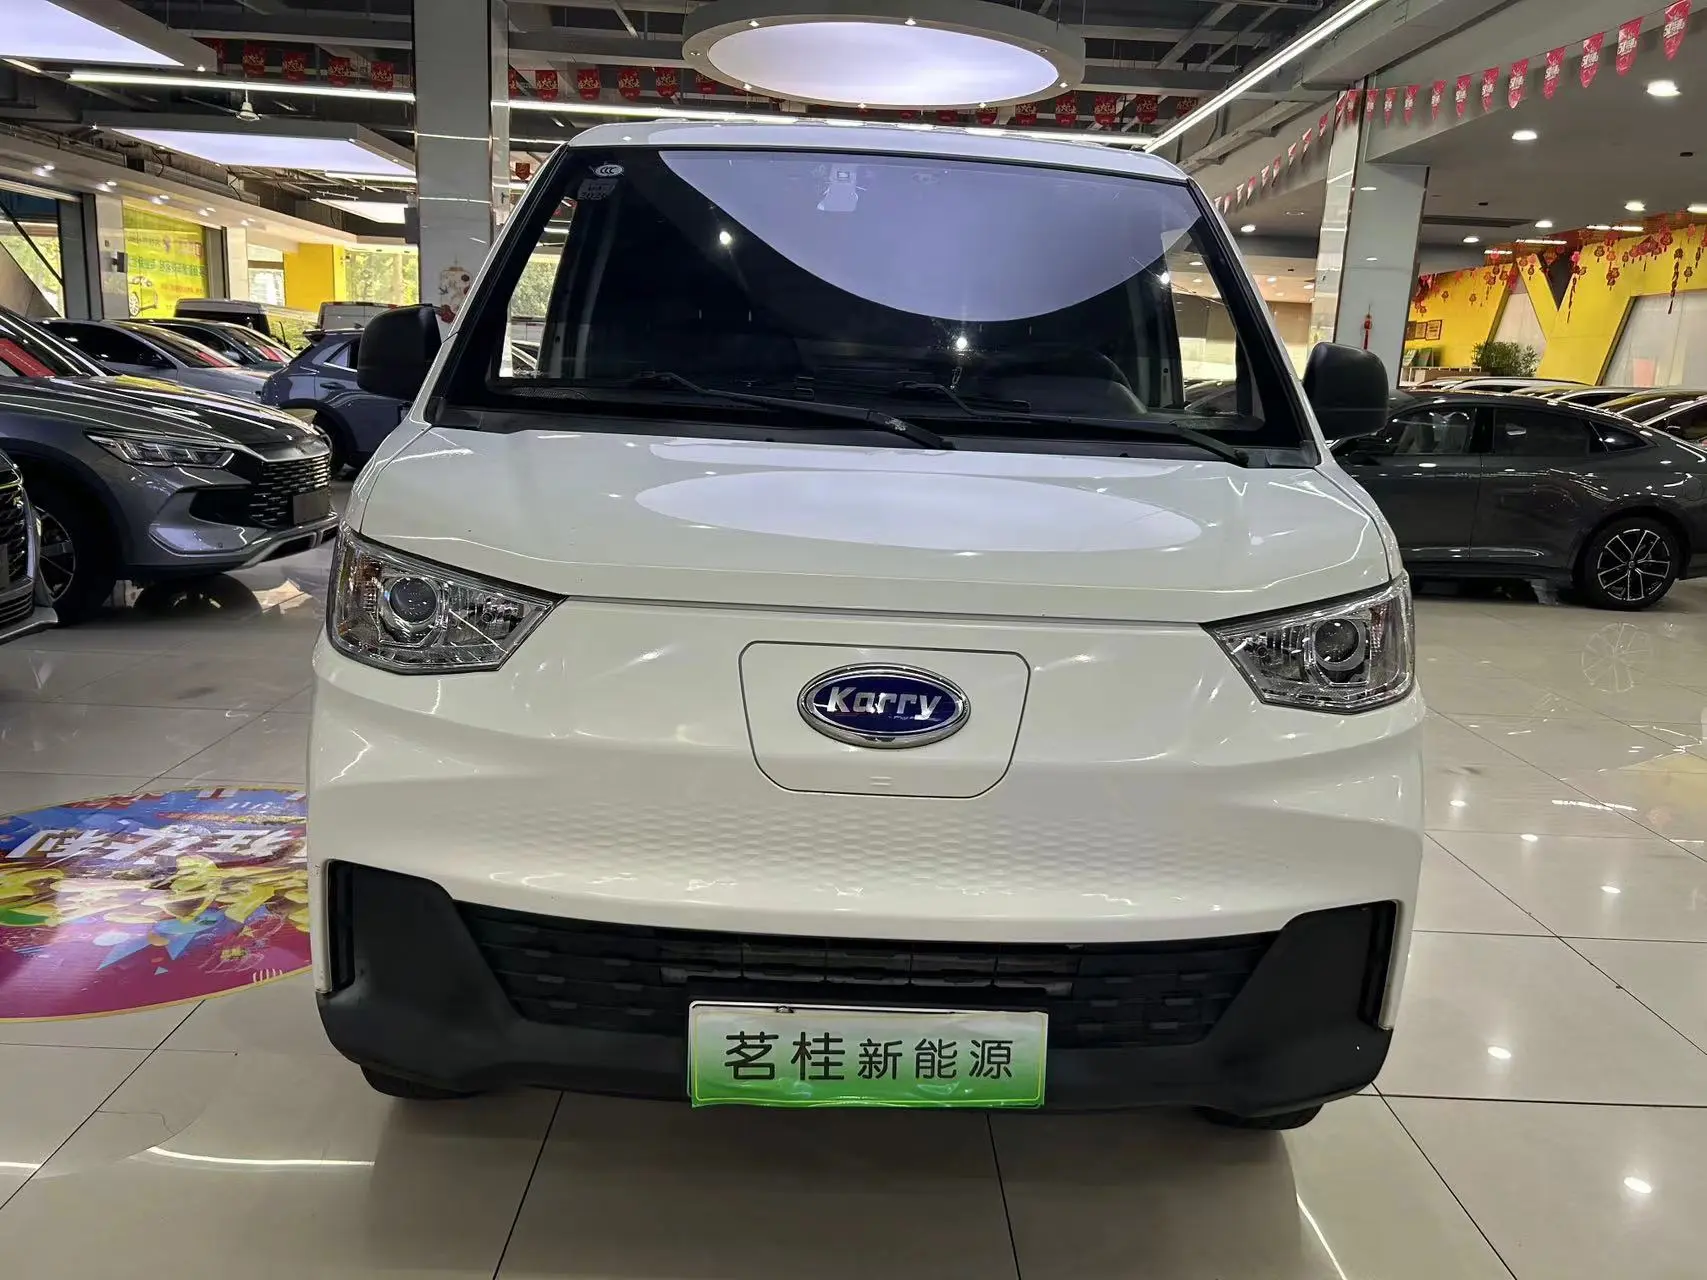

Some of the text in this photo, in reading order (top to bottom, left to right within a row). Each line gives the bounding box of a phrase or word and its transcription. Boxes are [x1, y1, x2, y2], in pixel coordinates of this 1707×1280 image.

[826, 686, 942, 721] Karry
[724, 1031, 1014, 1081] 茗桂新能源
